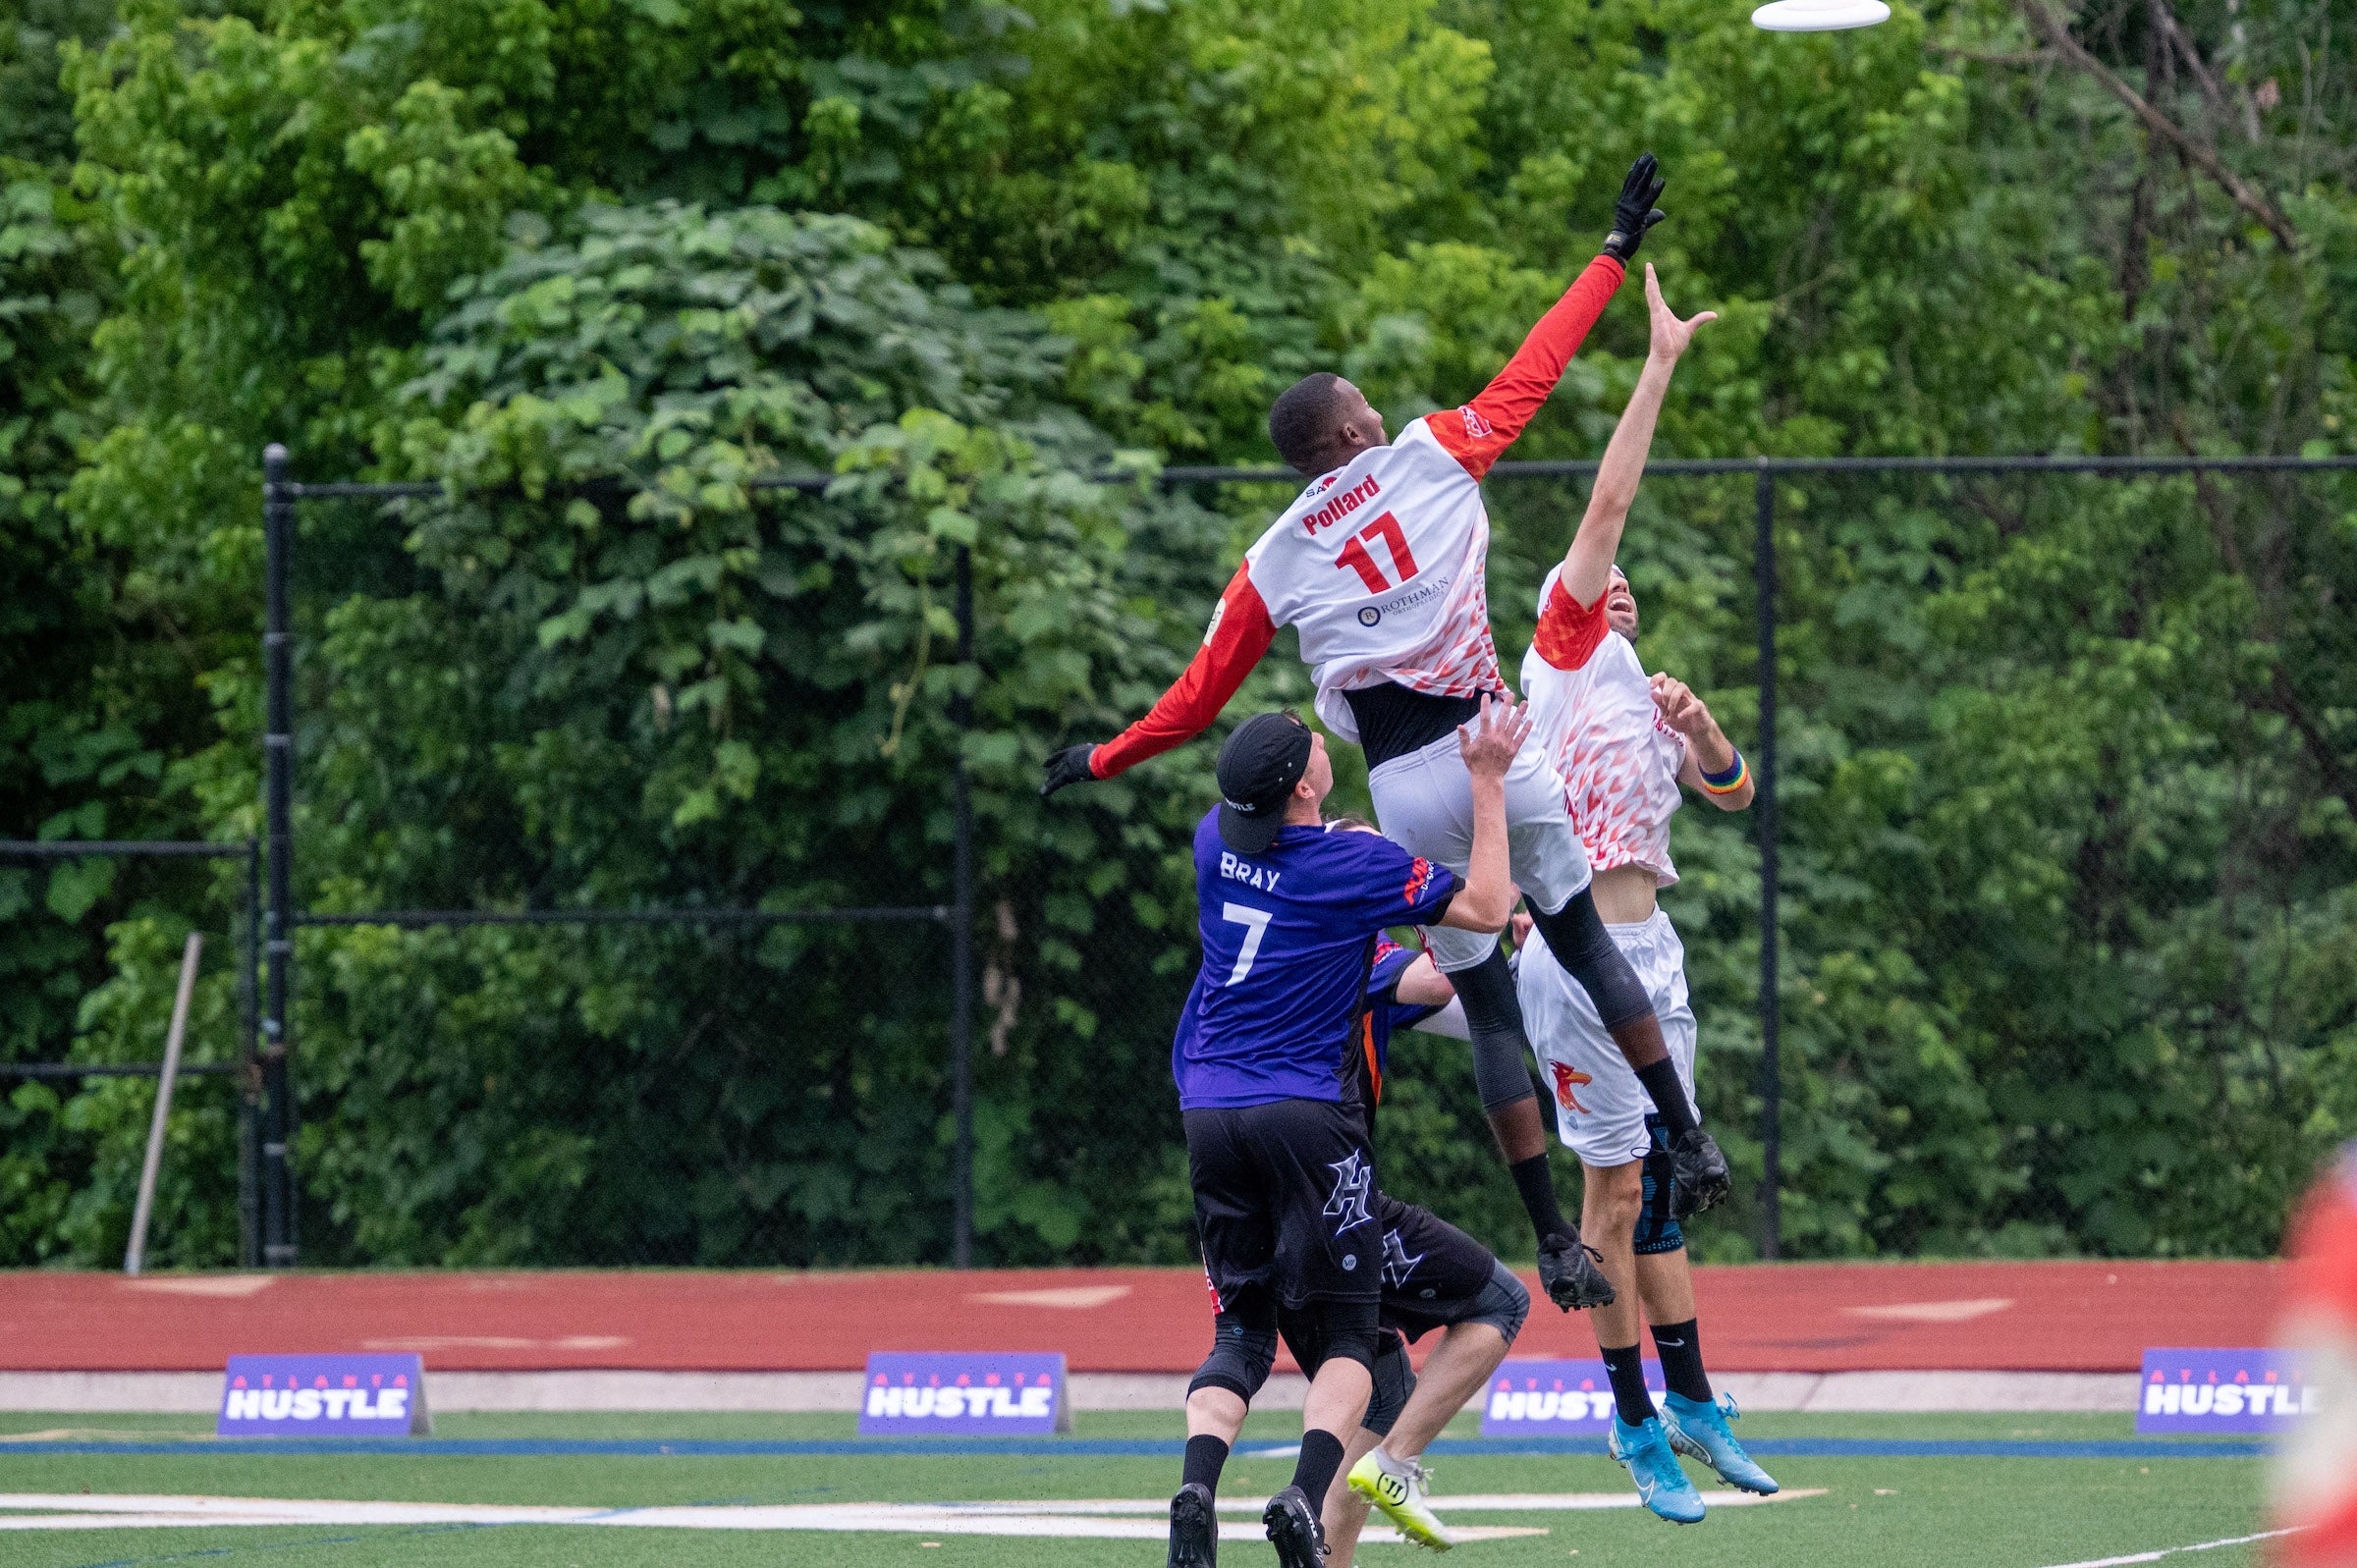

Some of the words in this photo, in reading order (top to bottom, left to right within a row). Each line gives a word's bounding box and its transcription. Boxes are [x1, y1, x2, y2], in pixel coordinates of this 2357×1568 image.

[1301, 473, 1381, 536] Pollard
[1335, 511, 1419, 595] 17
[1380, 576, 1450, 615] ROTHMAN
[1220, 851, 1281, 892] BRAY
[1222, 901, 1274, 988] 7
[225, 1387, 409, 1421] HUSTLE
[866, 1385, 1053, 1419] HUSTLE
[1488, 1390, 1667, 1421] HUST
